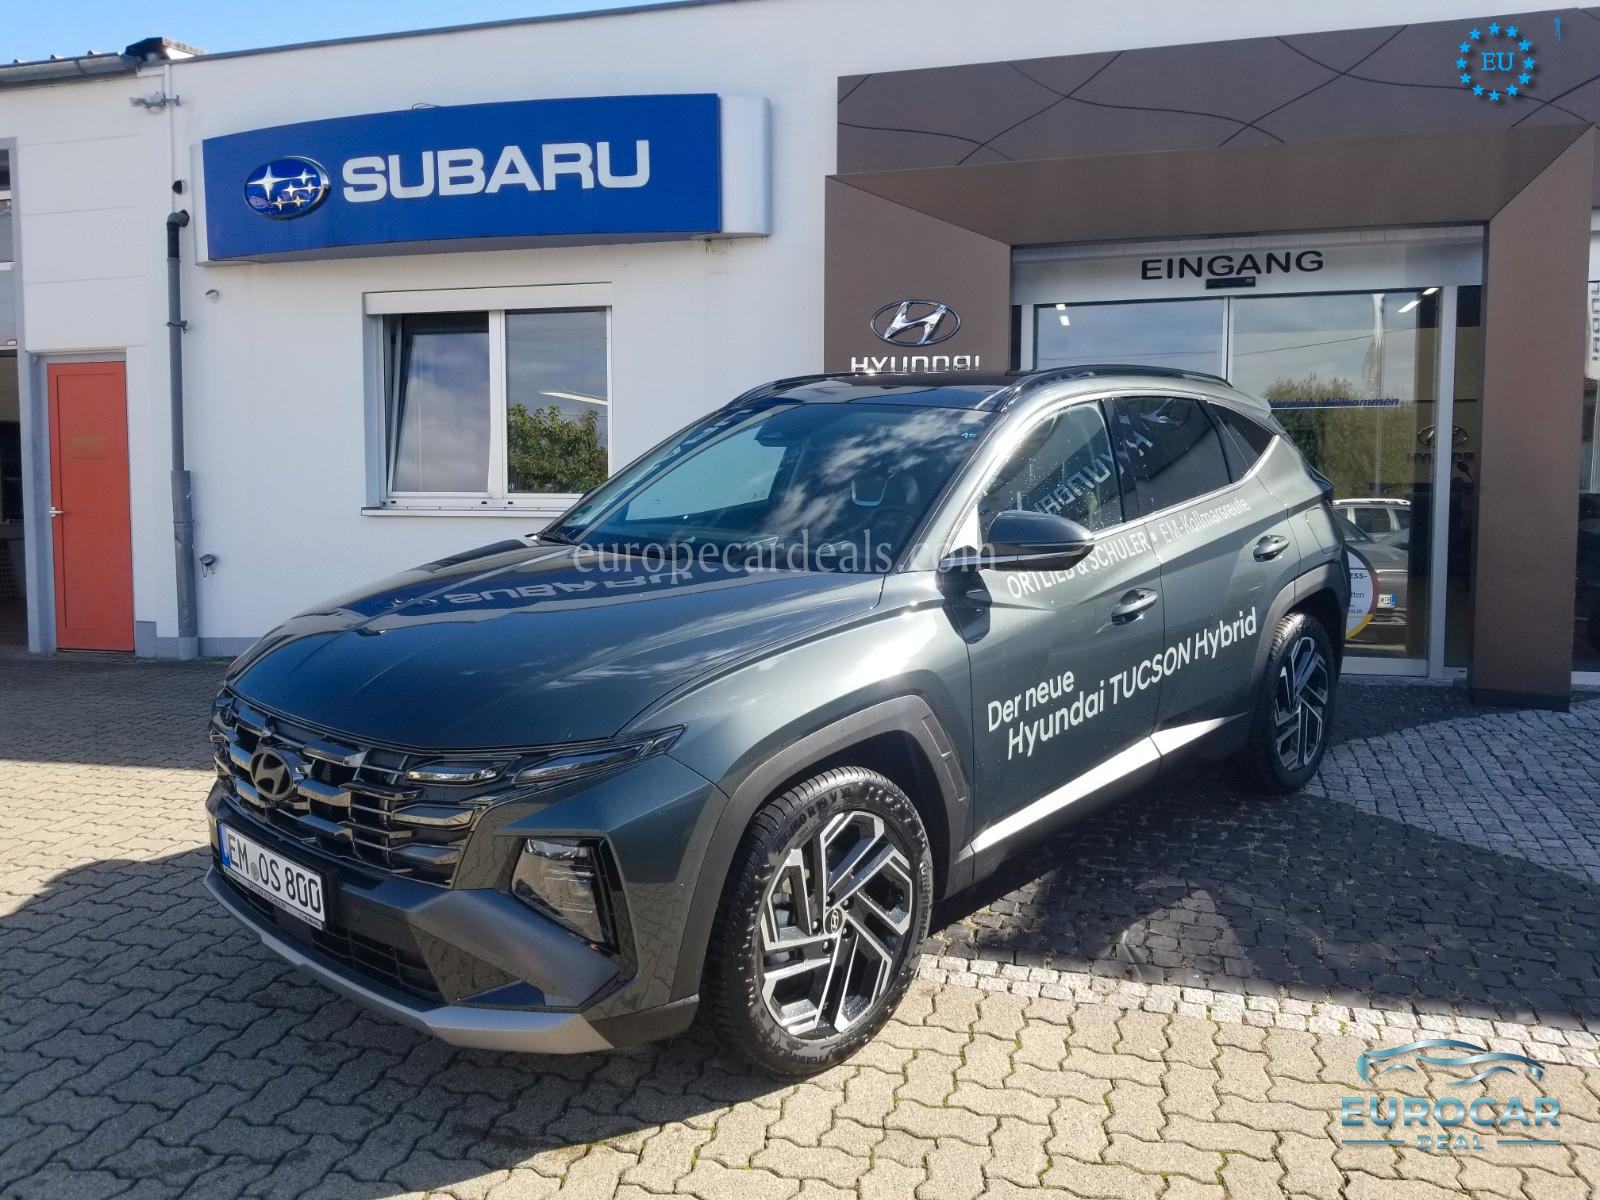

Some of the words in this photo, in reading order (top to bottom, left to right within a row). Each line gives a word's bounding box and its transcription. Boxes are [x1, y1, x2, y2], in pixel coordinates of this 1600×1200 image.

[342, 140, 650, 203] SUBARU
[1141, 250, 1324, 280] EINGANG
[851, 355, 980, 373] HYUNDAI
[1007, 567, 1077, 599] ORTLIEB
[1090, 530, 1153, 569] SCHULER
[1160, 496, 1251, 544] EM-Kollmarsreute
[987, 693, 1022, 733] Der
[1025, 670, 1075, 712] neue
[1007, 680, 1105, 760] Hyundai
[1109, 637, 1192, 705] TUCSON
[1193, 606, 1257, 660] Hybrid
[227, 832, 250, 876] EM
[258, 852, 281, 892] OS
[284, 866, 322, 914] 800
